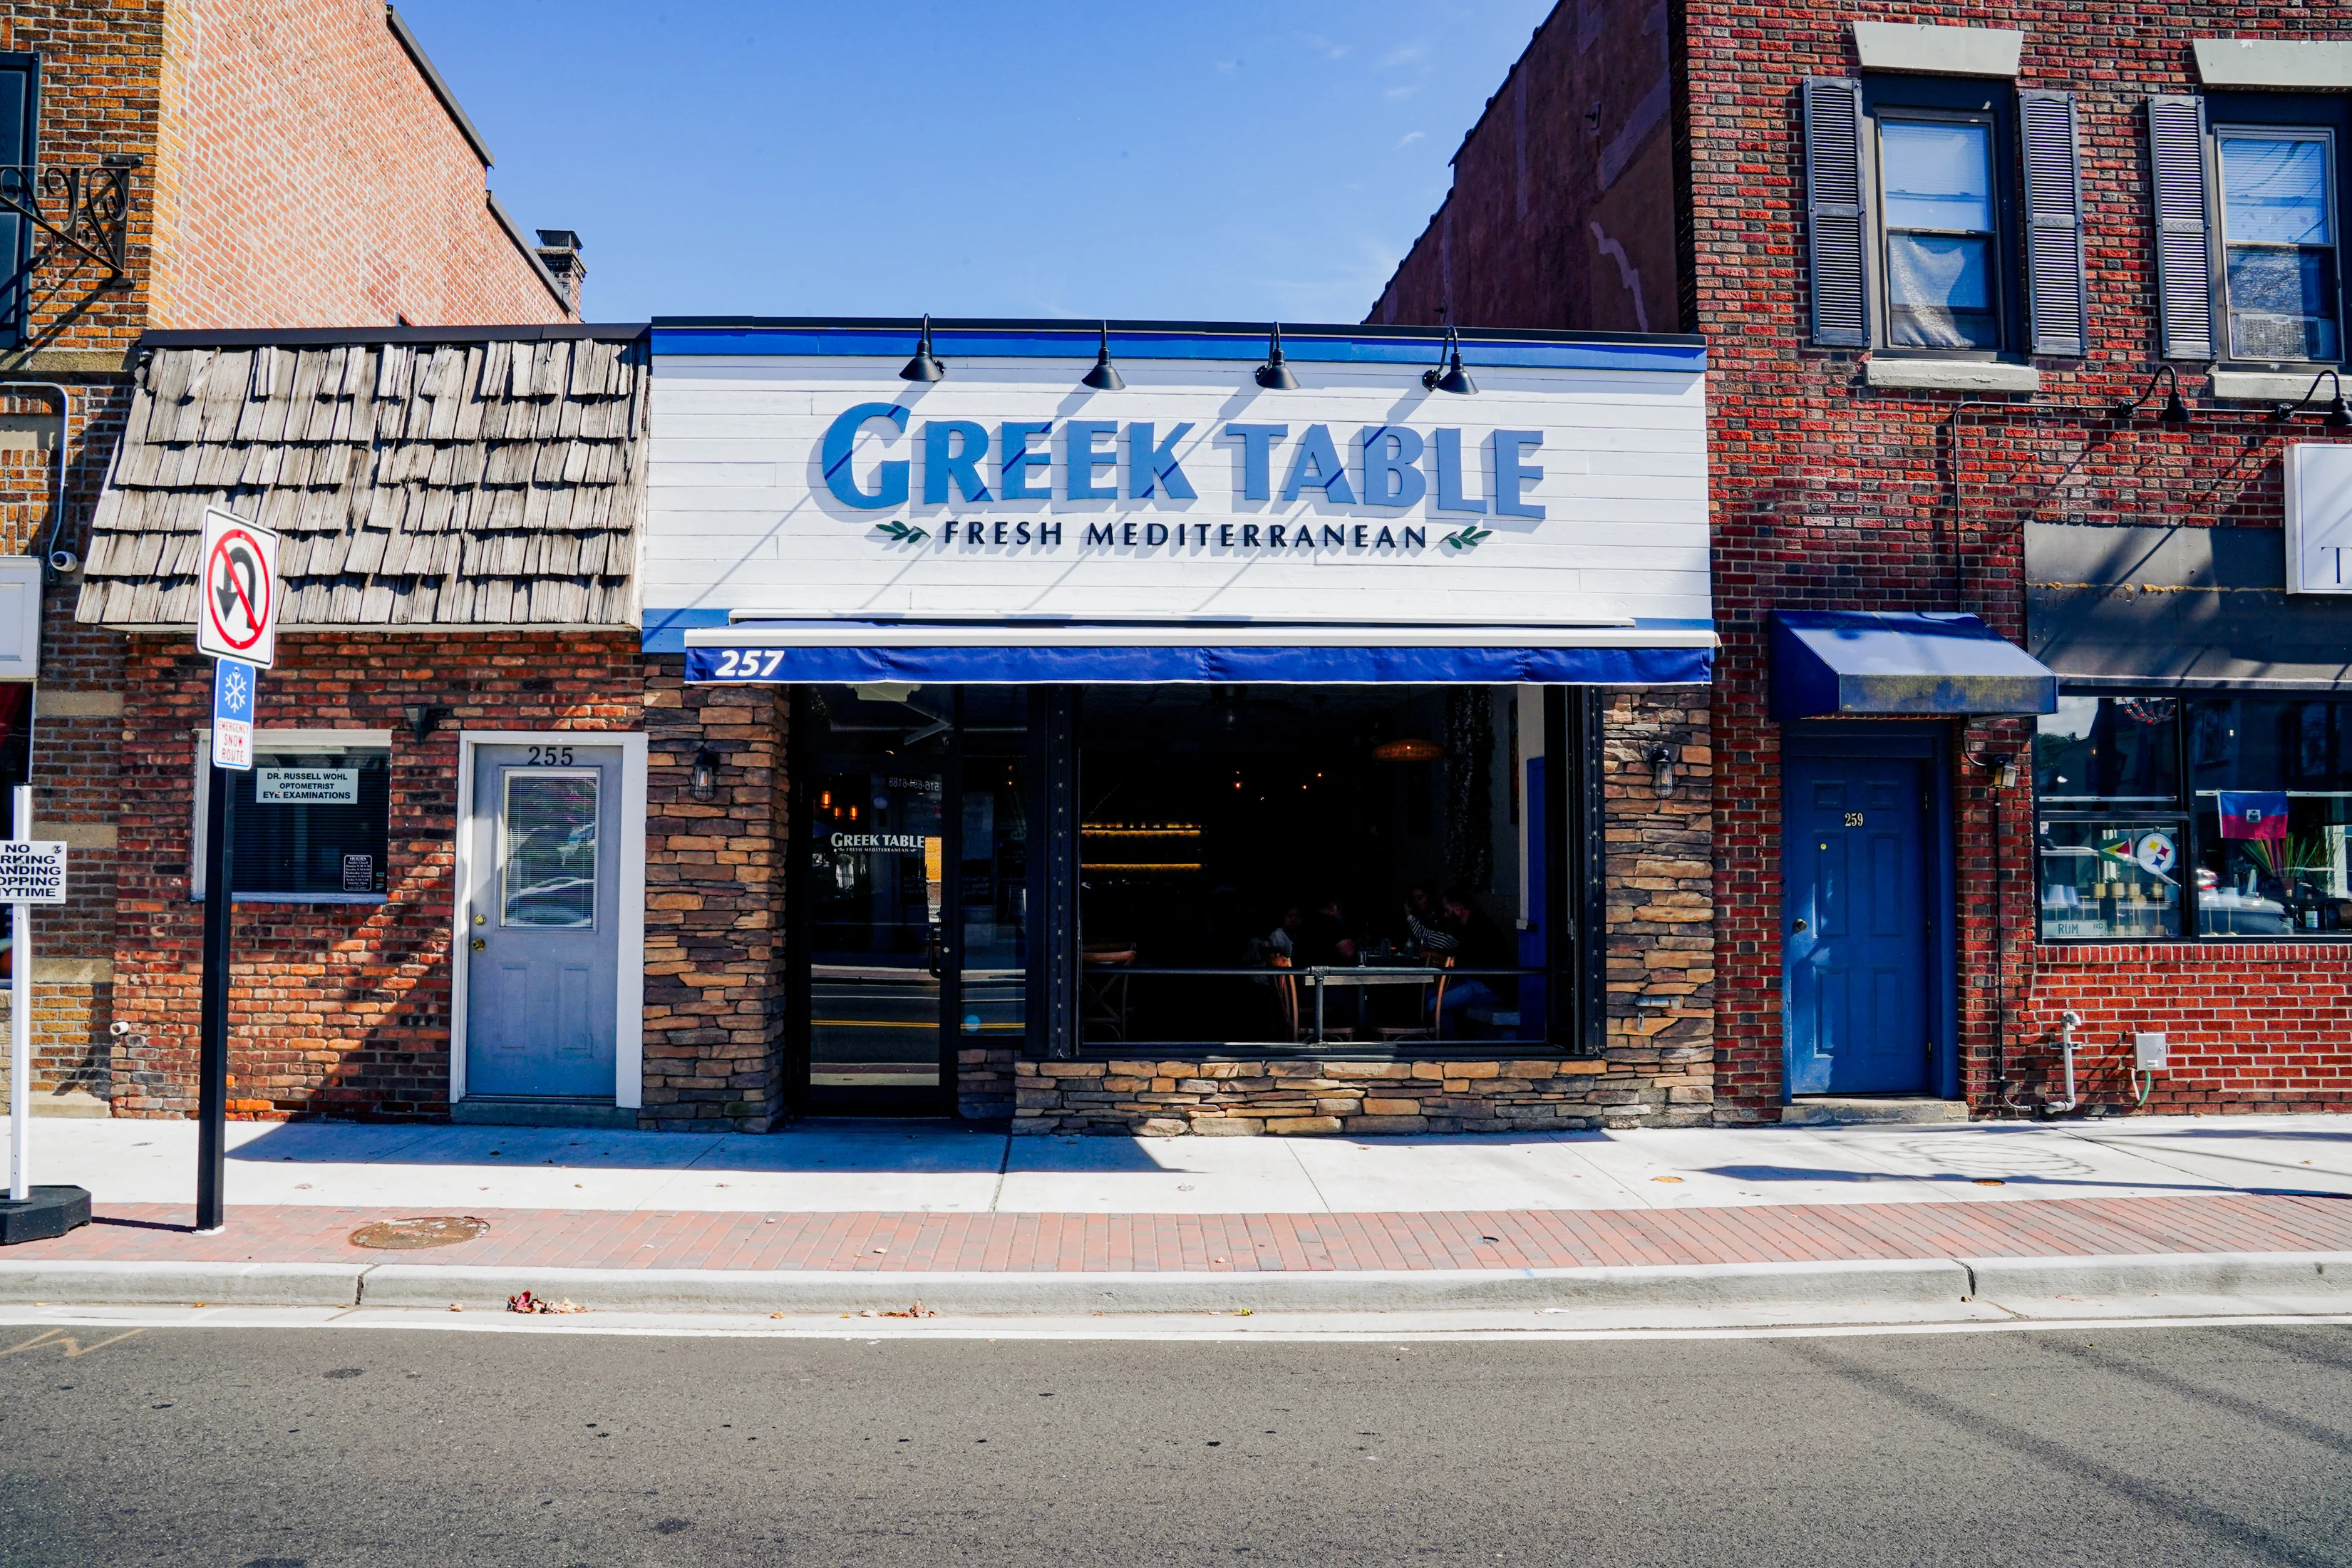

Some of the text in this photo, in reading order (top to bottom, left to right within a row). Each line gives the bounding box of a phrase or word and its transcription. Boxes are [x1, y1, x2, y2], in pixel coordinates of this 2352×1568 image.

[822, 401, 1547, 520] GREEK TABLE
[945, 521, 1426, 548] FRESH MEDITERRANEAN
[715, 649, 785, 677] 257
[218, 720, 249, 735] EMERGENCY
[224, 733, 243, 748] SNOW
[222, 748, 244, 763] ROUTE
[528, 747, 574, 766] 255
[1845, 812, 1863, 827] 259
[831, 832, 924, 848] GREEK TABLE
[2058, 924, 2079, 935] RUM
